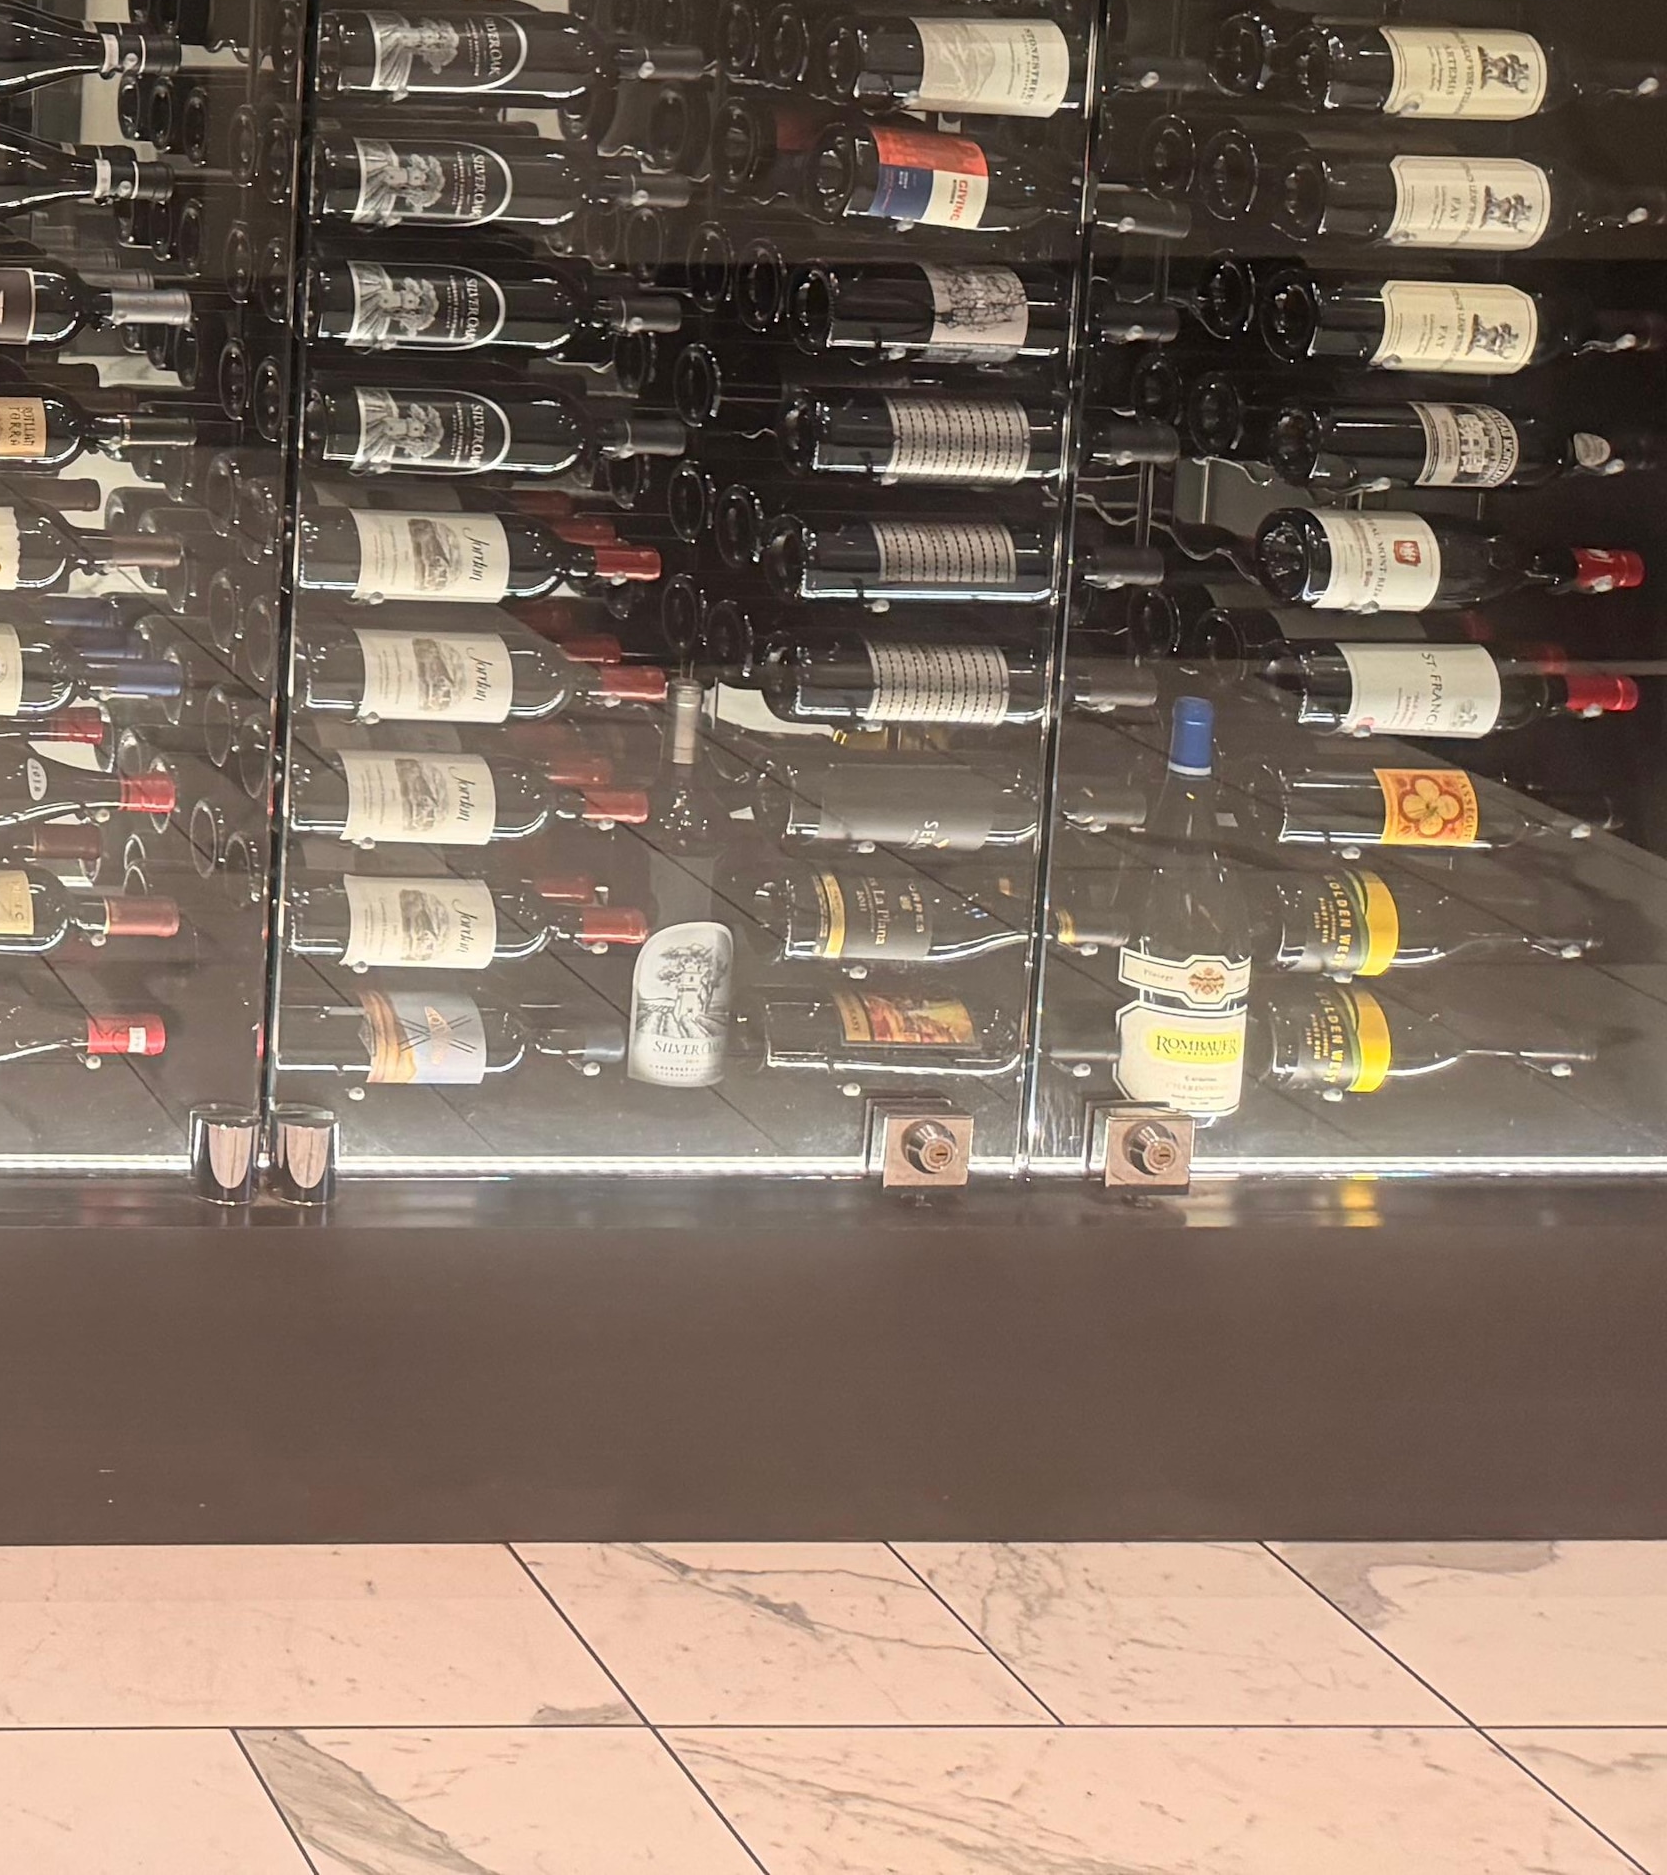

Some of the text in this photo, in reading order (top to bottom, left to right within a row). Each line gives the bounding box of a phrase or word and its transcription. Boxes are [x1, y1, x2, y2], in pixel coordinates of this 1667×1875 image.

[488, 49, 503, 75] OAK
[1444, 45, 1457, 96] ARTEMIS
[467, 153, 485, 219] SILVER OAK
[949, 180, 969, 222] GIVING
[1449, 197, 1460, 223] FAY
[465, 277, 481, 341] SILVER OAK
[1434, 325, 1448, 350] FAY
[9, 406, 23, 447] TORRA
[469, 403, 485, 467] SILVER OAK
[465, 533, 491, 581] Jordan
[469, 649, 494, 702] Jordan
[451, 768, 477, 821] Jordan
[452, 901, 479, 953] Jordan
[875, 890, 892, 946] La Plana
[1330, 934, 1352, 967] WEST
[653, 1040, 698, 1056] SILVER
[1156, 1033, 1238, 1054] ROMBAUER
[1323, 1050, 1344, 1082] WEST
